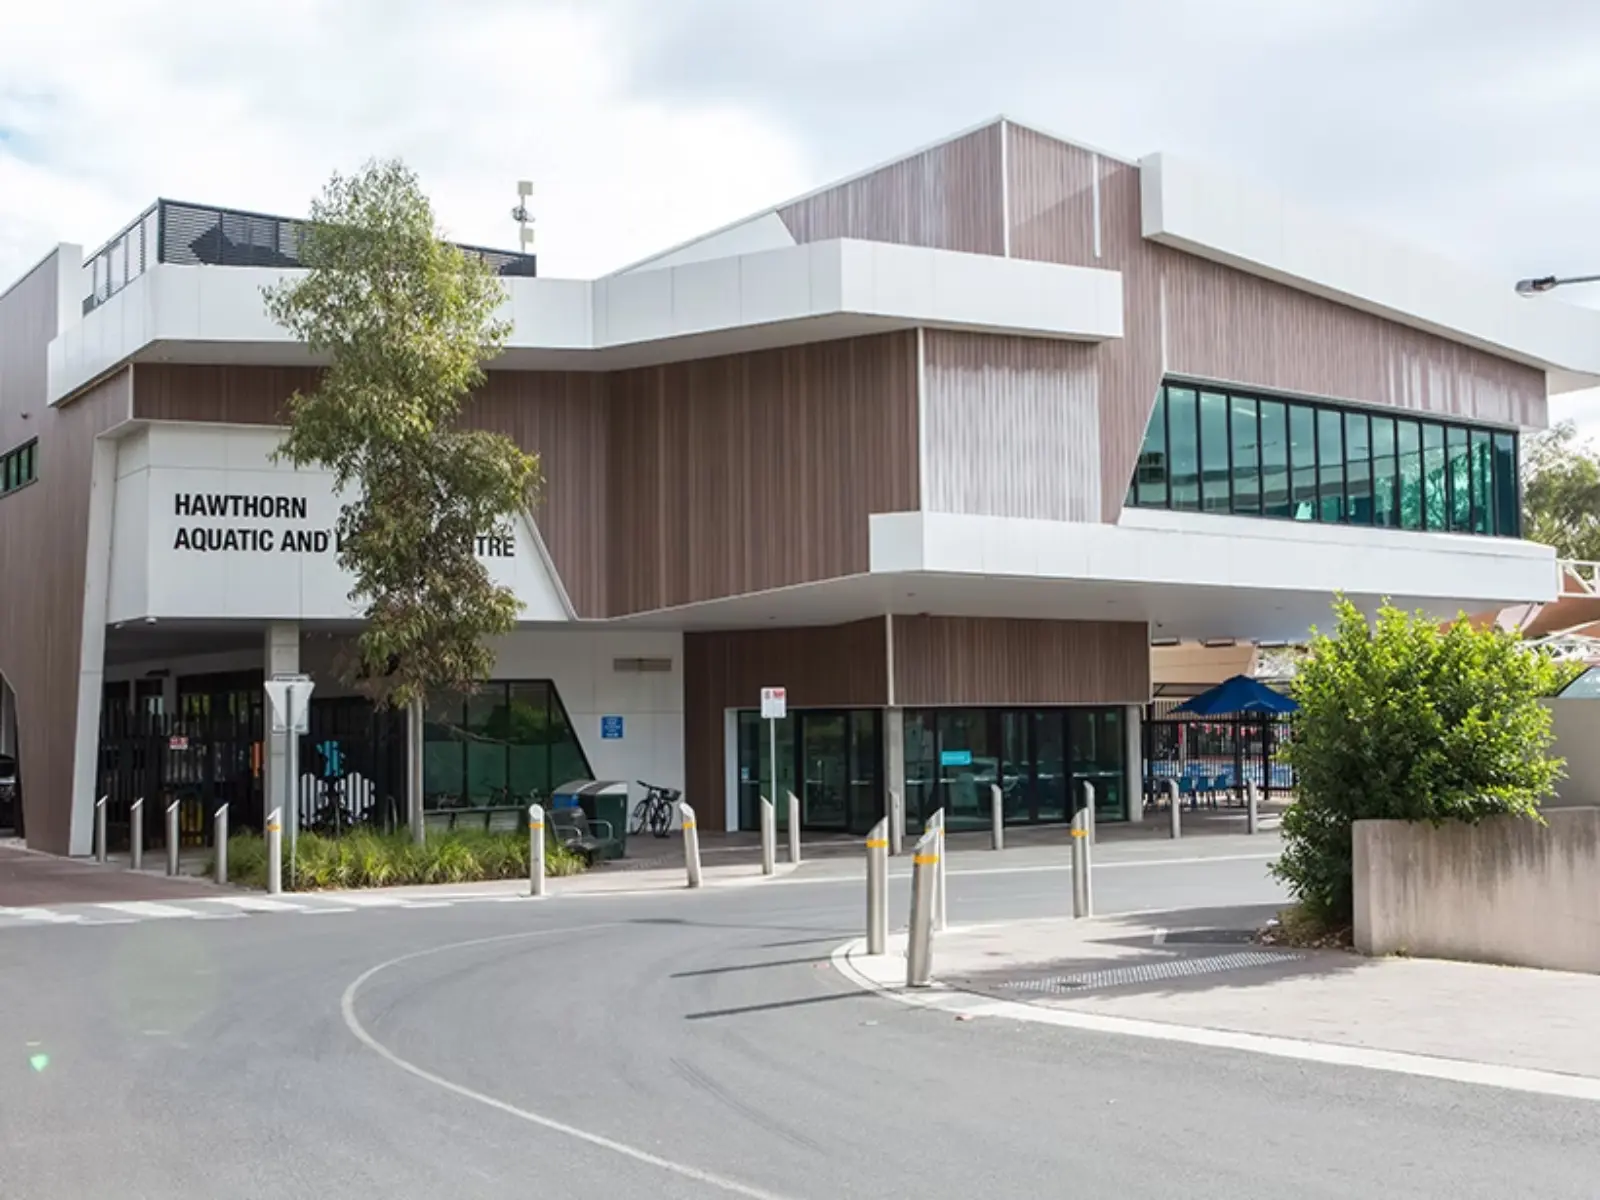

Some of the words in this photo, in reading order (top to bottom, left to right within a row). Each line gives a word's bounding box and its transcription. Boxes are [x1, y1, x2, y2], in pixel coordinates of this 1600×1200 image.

[174, 493, 307, 519] HAWTHORN
[173, 527, 274, 552] AQUATIC
[280, 530, 329, 553] AND
[470, 534, 515, 558] TRE
